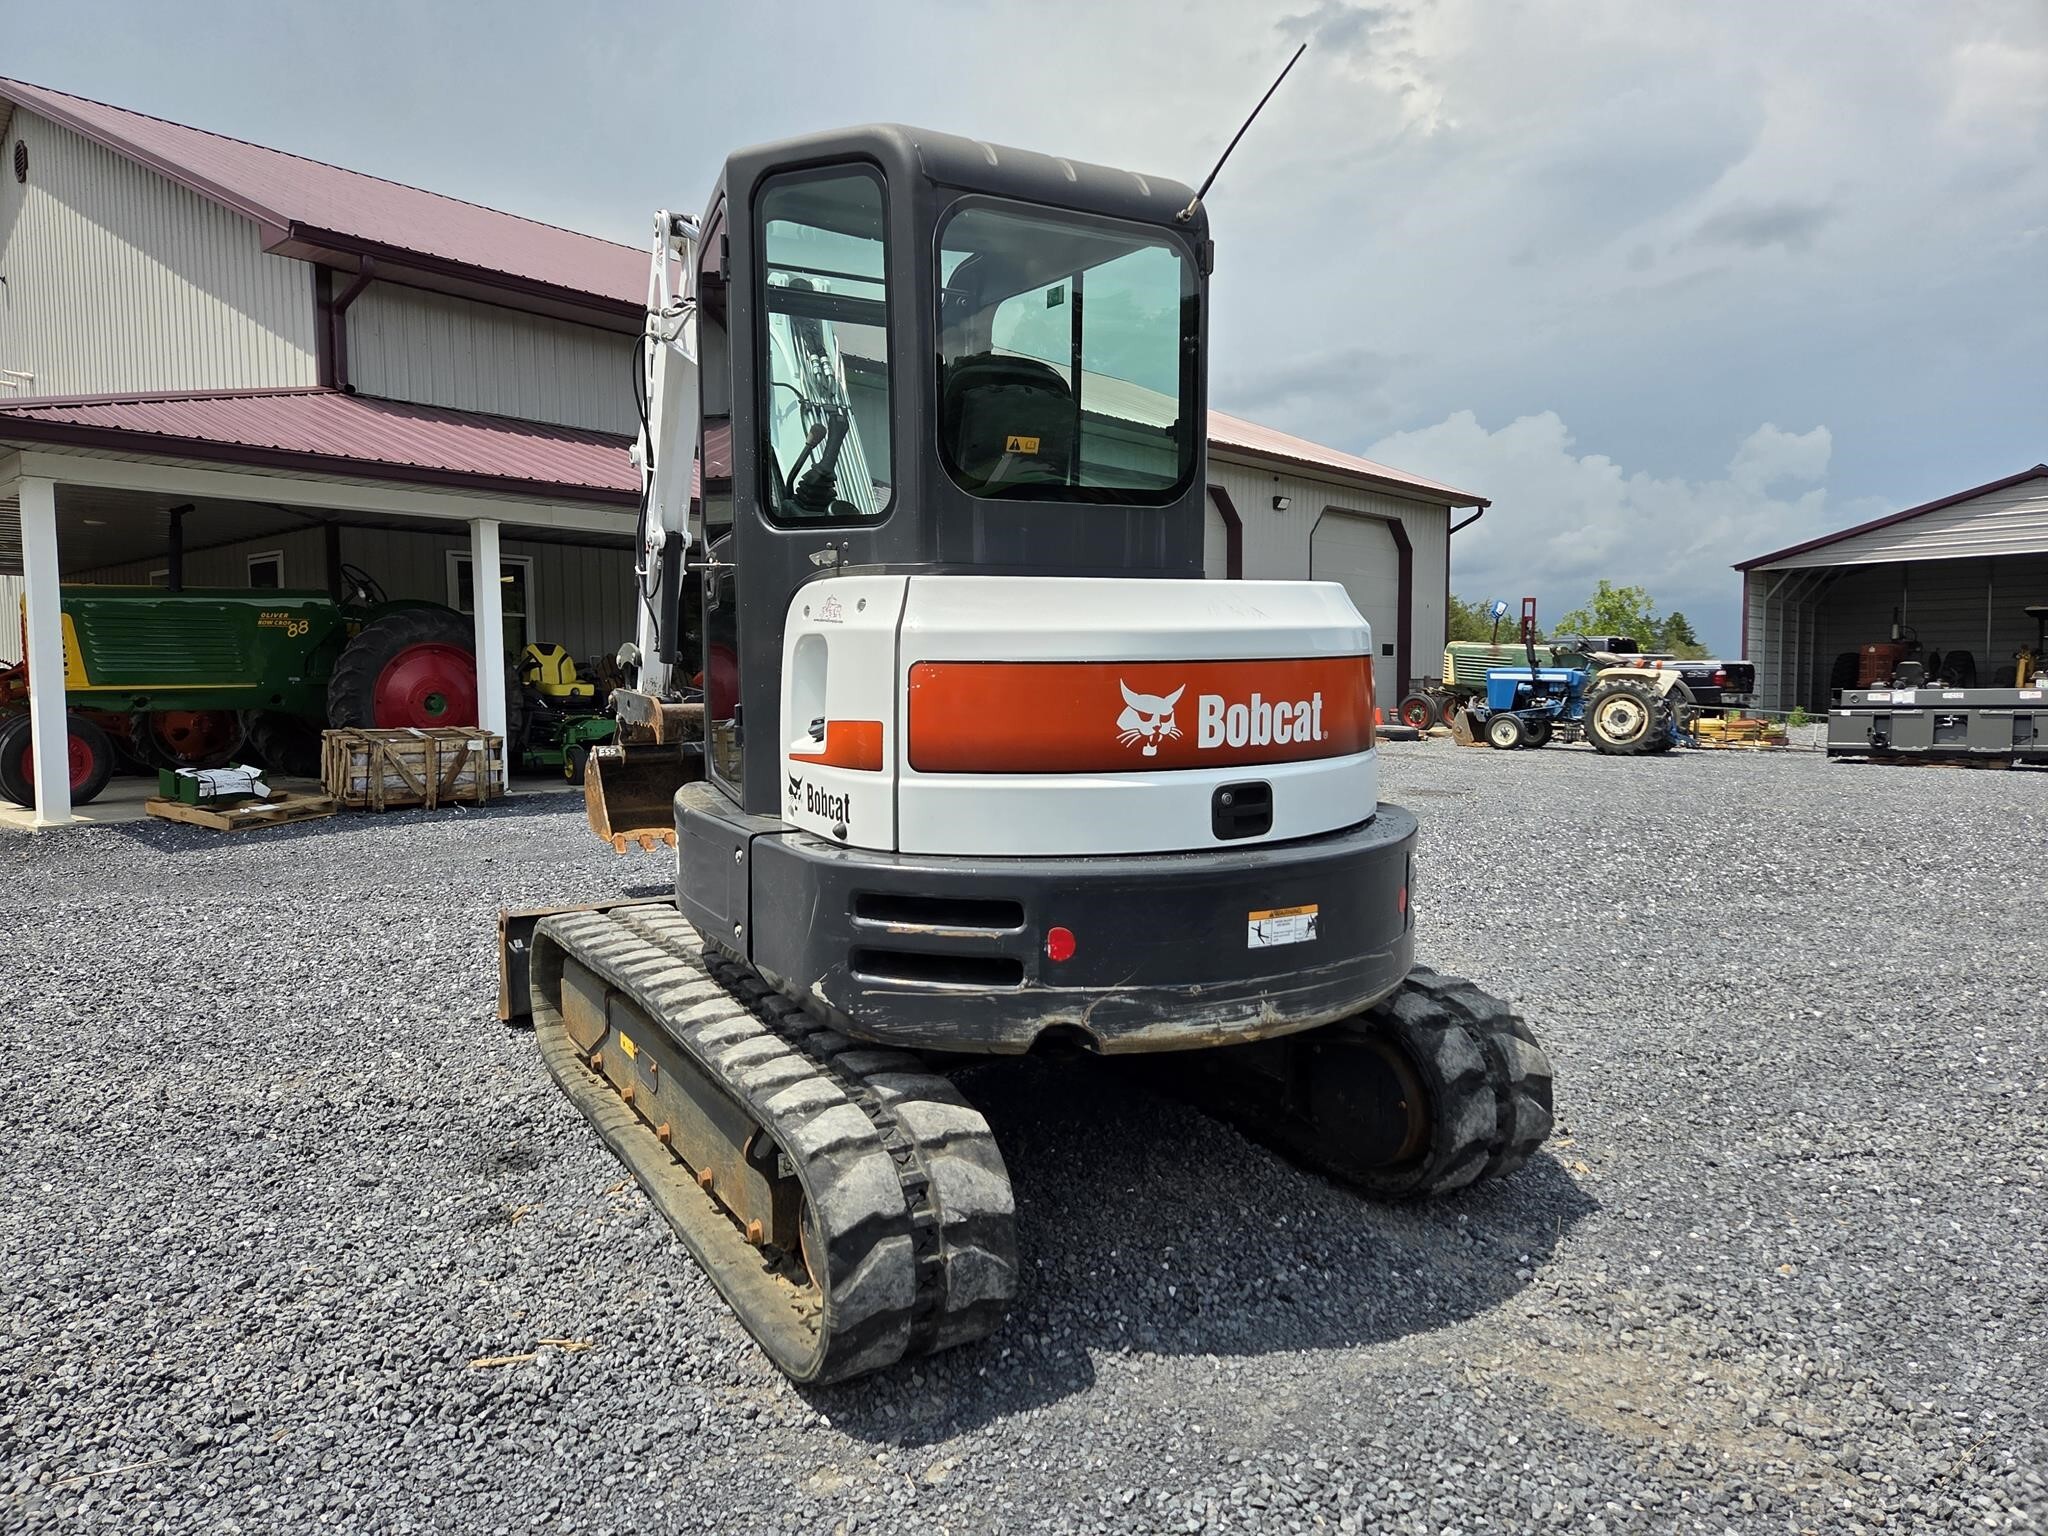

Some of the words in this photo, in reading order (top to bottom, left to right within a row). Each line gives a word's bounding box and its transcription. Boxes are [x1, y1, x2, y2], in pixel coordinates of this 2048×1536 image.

[287, 620, 309, 638] 88
[1197, 691, 1323, 749] Bobcat
[806, 782, 850, 824] Bobcat
